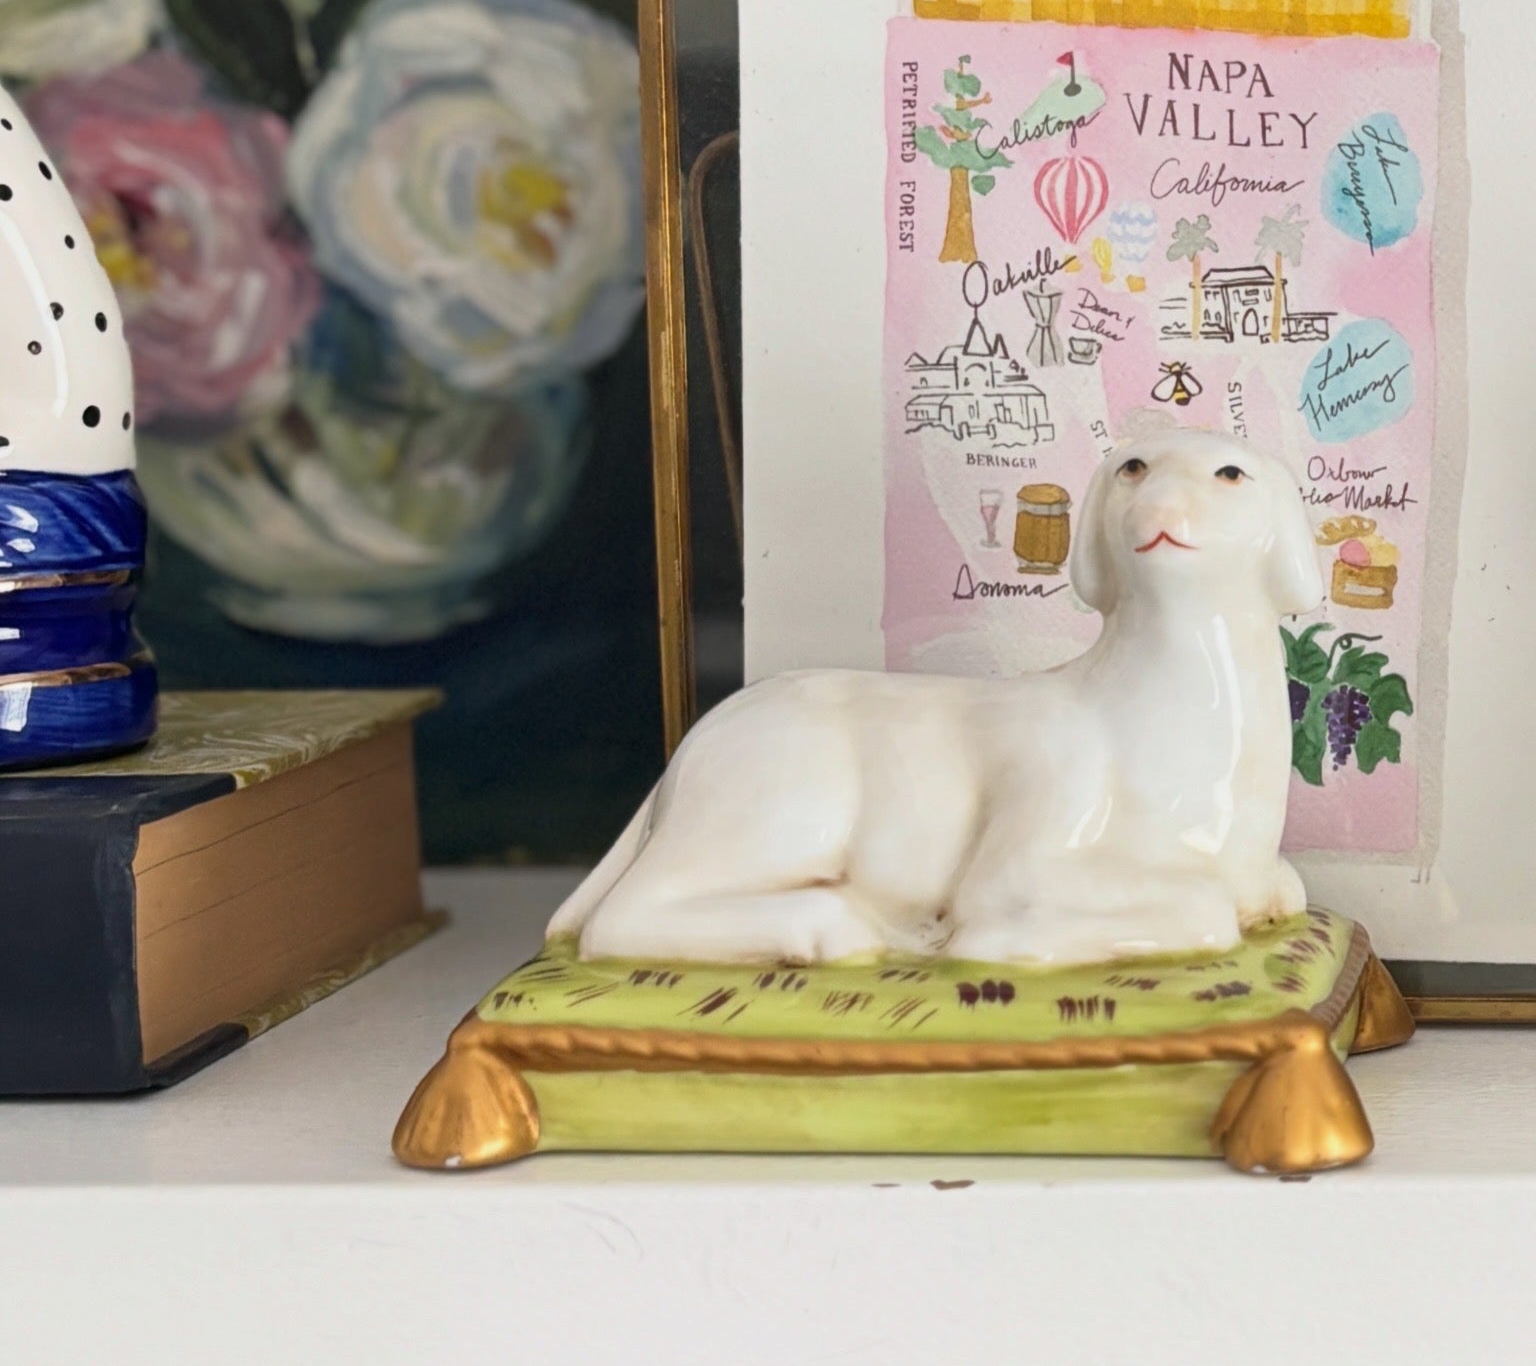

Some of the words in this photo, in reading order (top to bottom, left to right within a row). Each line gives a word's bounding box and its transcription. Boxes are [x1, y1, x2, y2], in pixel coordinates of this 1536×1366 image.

[1167, 52, 1275, 98] NAPA
[901, 61, 918, 164] PETRIFIED
[974, 111, 1101, 160] Calistoga
[1122, 93, 1318, 149] VALLEY
[1150, 158, 1304, 207] California
[899, 180, 915, 253] FOREST
[962, 247, 1078, 308] Oakville
[1313, 339, 1390, 391] Lake
[1227, 381, 1248, 438] SILVE
[966, 453, 1038, 469] BERINGER
[952, 563, 1070, 601] Sonoma
